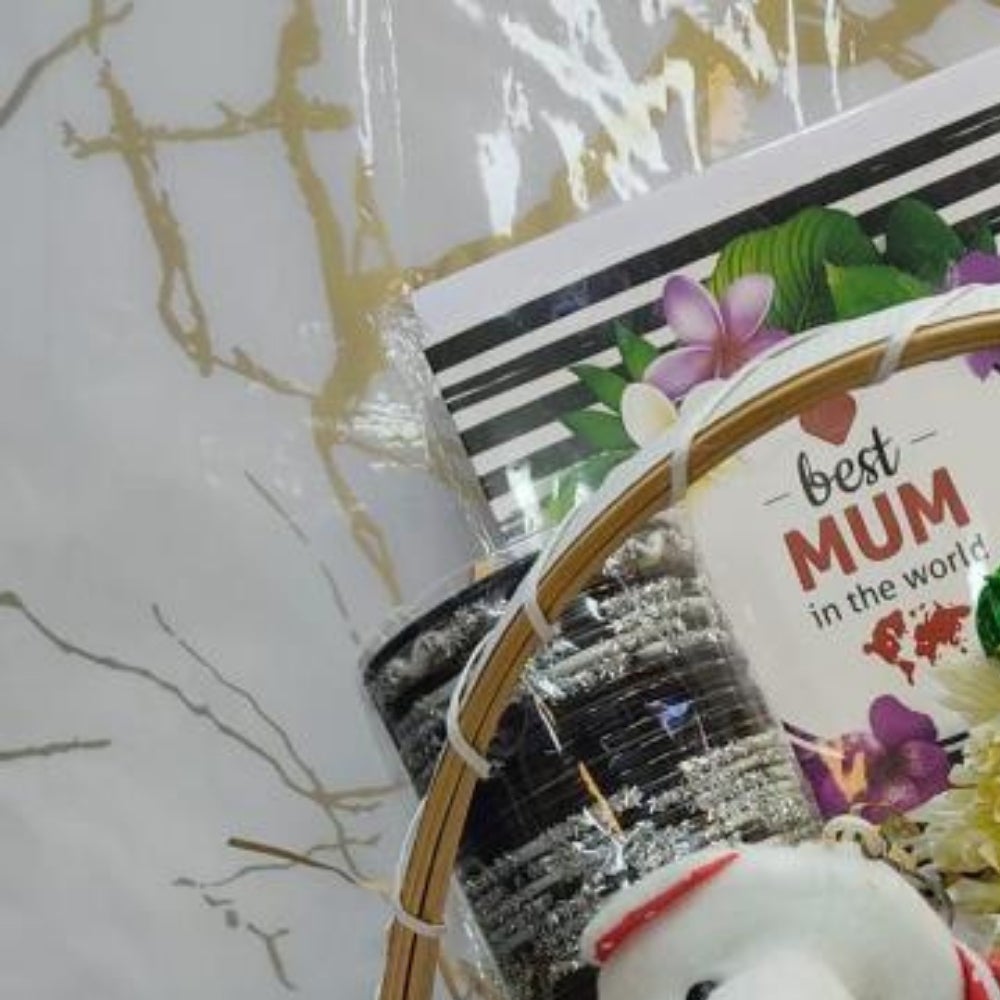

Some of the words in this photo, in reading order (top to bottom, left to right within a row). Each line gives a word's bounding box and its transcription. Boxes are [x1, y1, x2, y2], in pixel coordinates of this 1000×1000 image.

[797, 425, 901, 506] best
[783, 466, 970, 592] MUM
[807, 602, 843, 629] in
[846, 579, 897, 613] the
[902, 532, 990, 590] world
